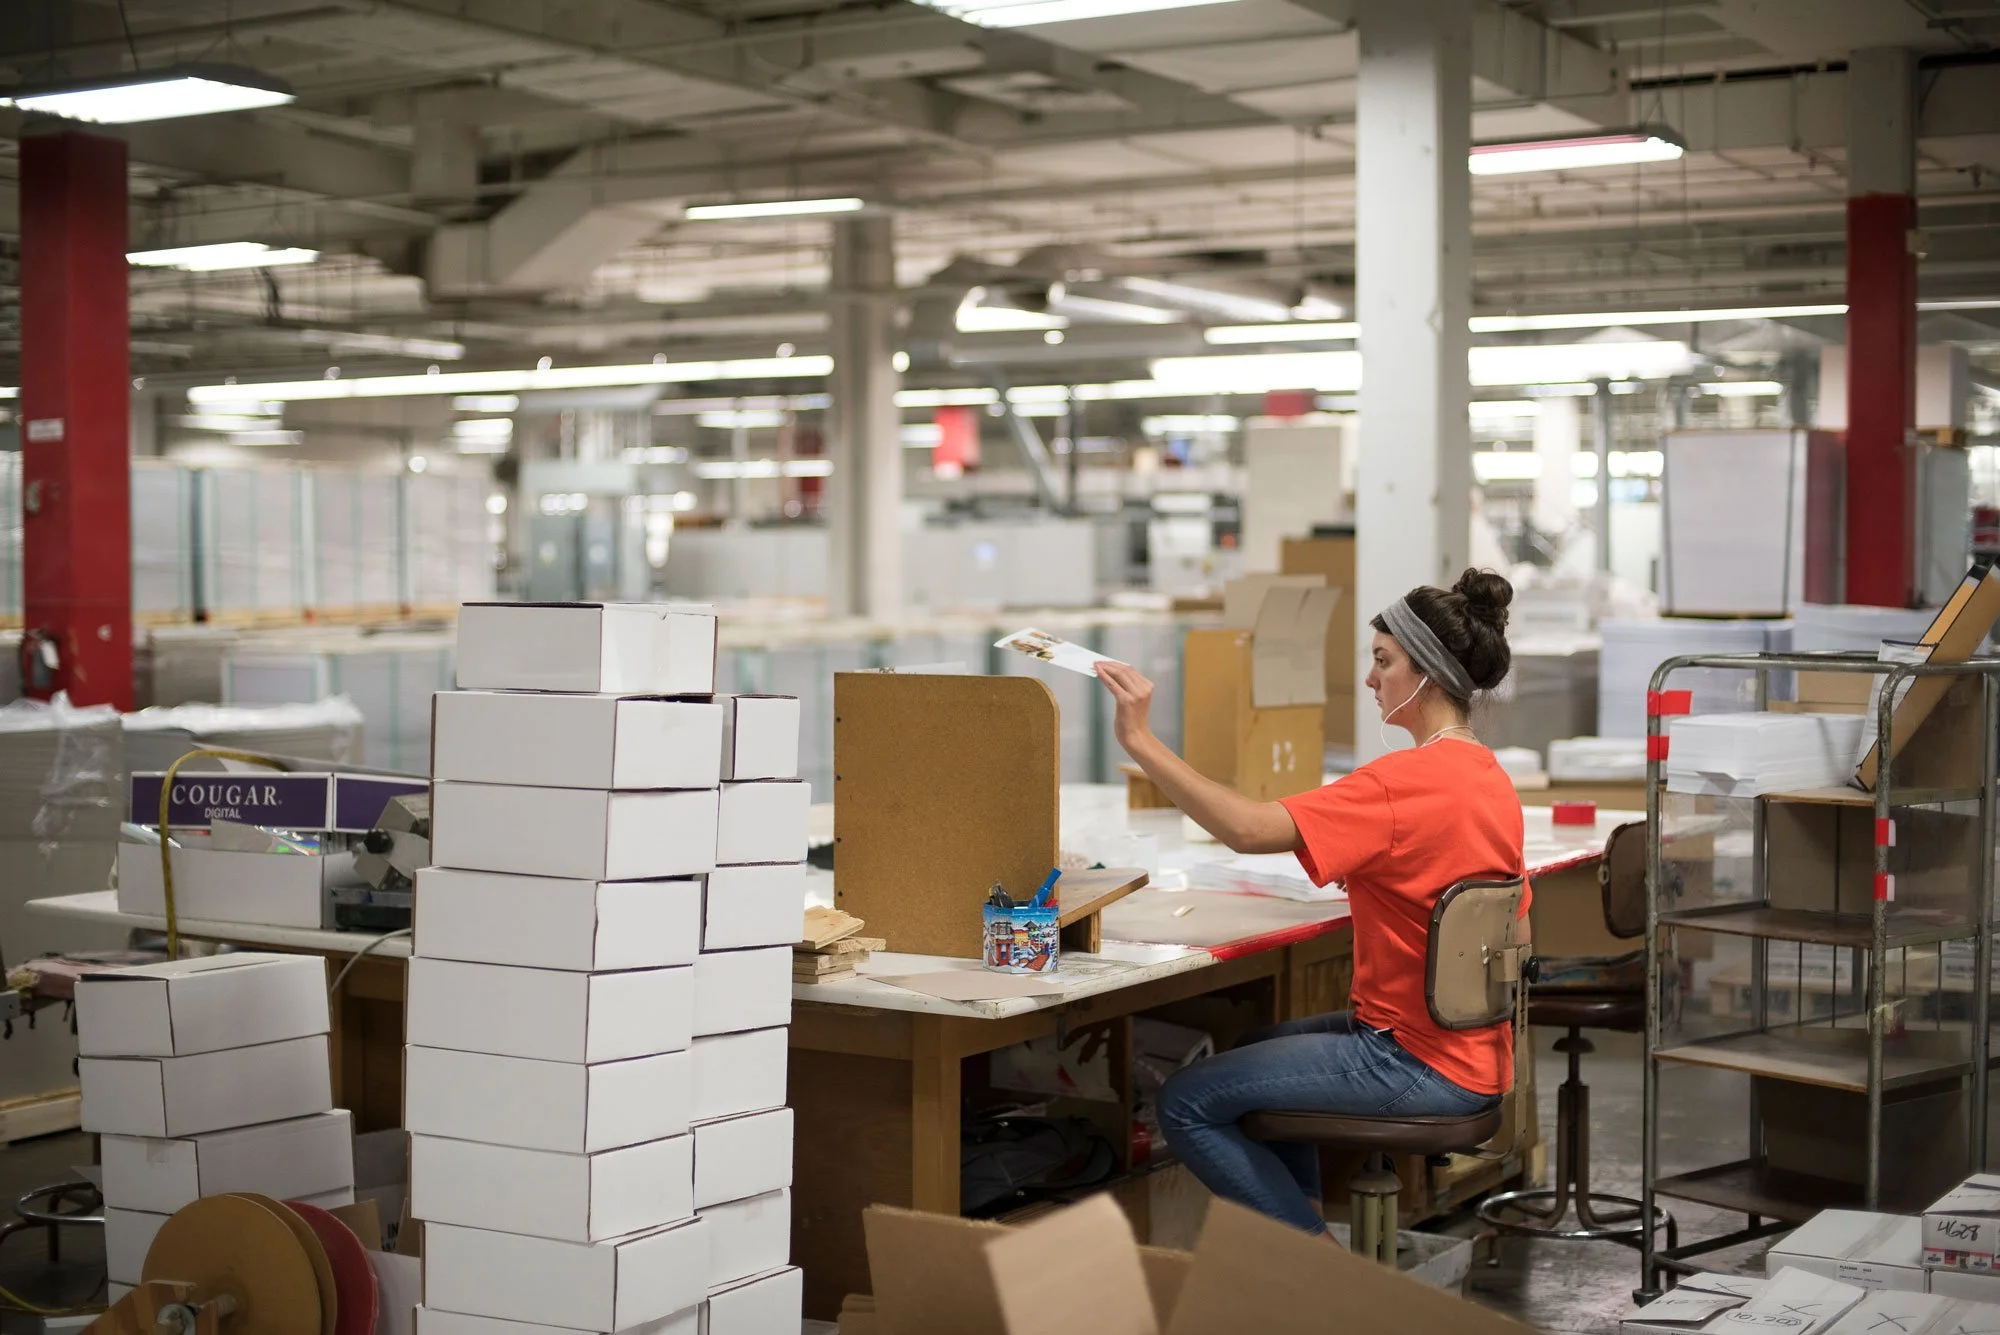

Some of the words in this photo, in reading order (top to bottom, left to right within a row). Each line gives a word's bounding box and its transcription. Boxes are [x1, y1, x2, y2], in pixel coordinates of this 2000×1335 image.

[171, 783, 278, 806] COUGAR
[204, 806, 242, 820] DIGITAL
[1937, 1218, 1982, 1242] 4628
